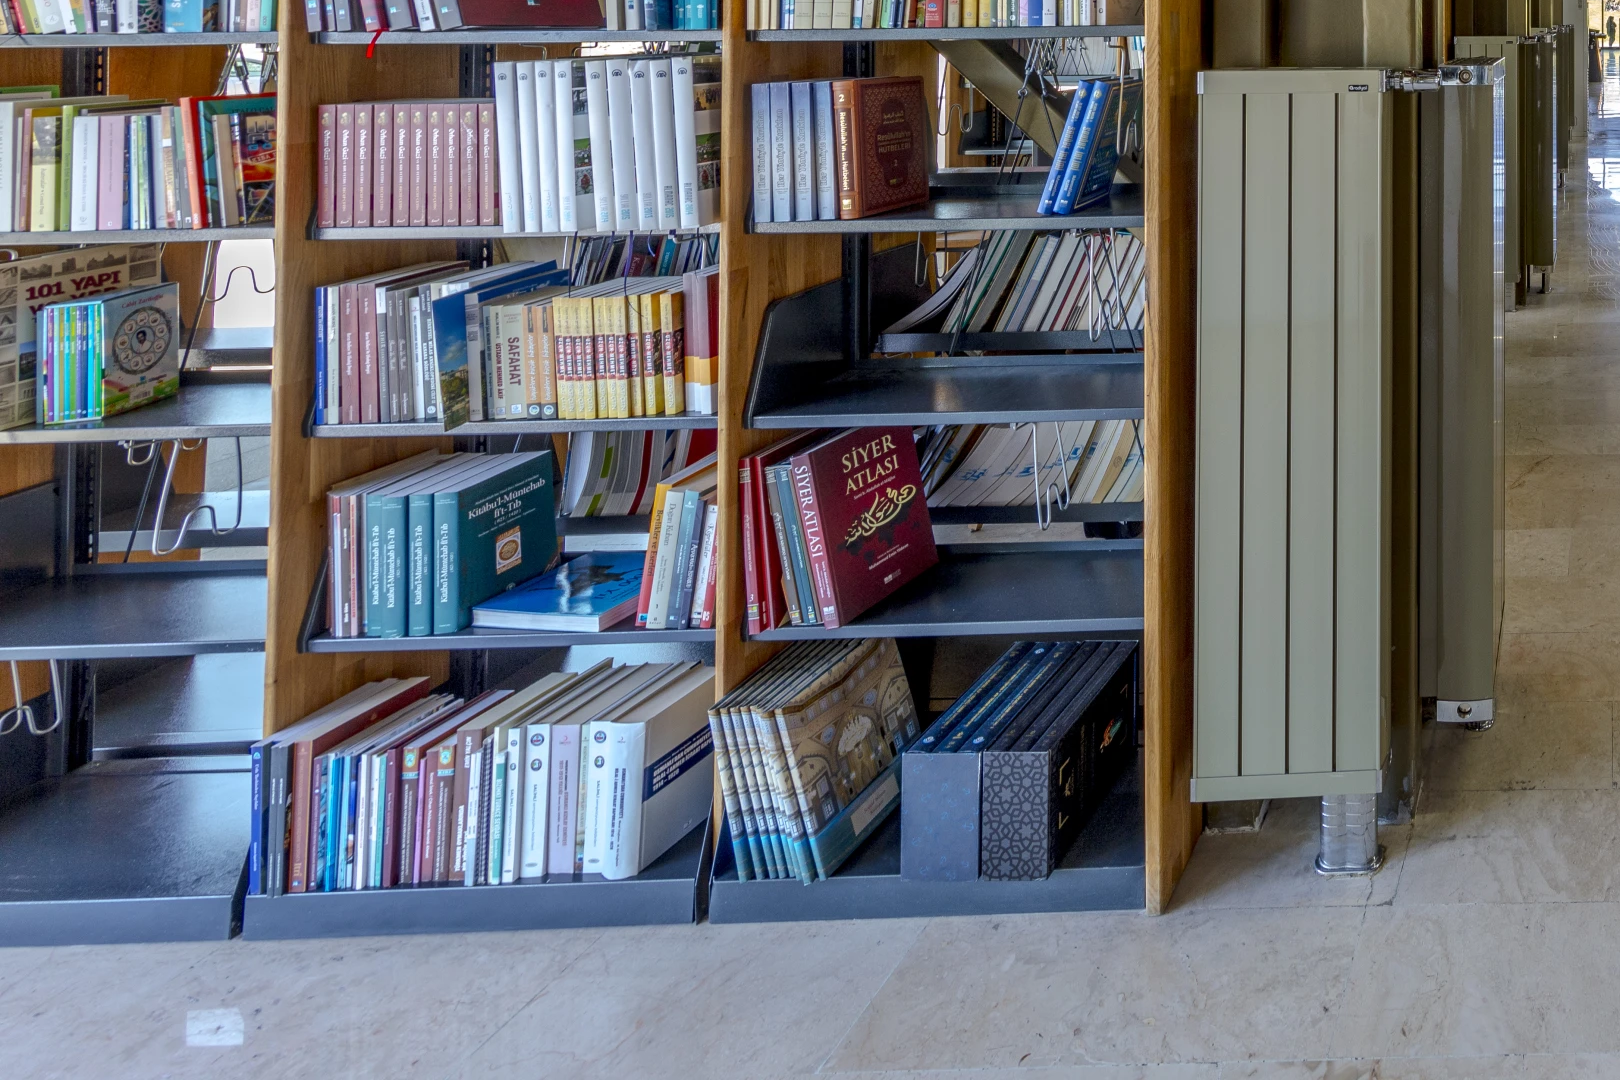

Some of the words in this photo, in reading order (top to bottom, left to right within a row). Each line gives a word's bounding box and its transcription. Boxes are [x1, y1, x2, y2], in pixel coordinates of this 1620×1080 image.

[839, 94, 844, 102] 2
[757, 144, 767, 172] Yönüyle
[776, 144, 786, 171] Yönüyle
[798, 144, 807, 171] Yönüyle
[819, 143, 828, 171] Yönüyle
[878, 142, 911, 154] HUTBELERİ
[777, 172, 785, 187] Her
[842, 161, 850, 191] Hutbeleri
[25, 282, 65, 301] 101
[71, 270, 121, 291] YAPI
[122, 300, 138, 309] Cahit
[495, 342, 504, 364] ÜSTADIM
[507, 336, 521, 386] SAFAHAT
[841, 434, 897, 473] SİYER
[794, 465, 813, 507] SİYER
[845, 454, 899, 495] ATLASI
[651, 508, 663, 539] Beylikler
[665, 502, 677, 524] Doğan
[651, 541, 657, 549] ve
[663, 524, 673, 546] Kuban
[803, 508, 824, 558] ATLASI
[647, 550, 657, 577] Eserleri
[749, 594, 754, 602] 3
